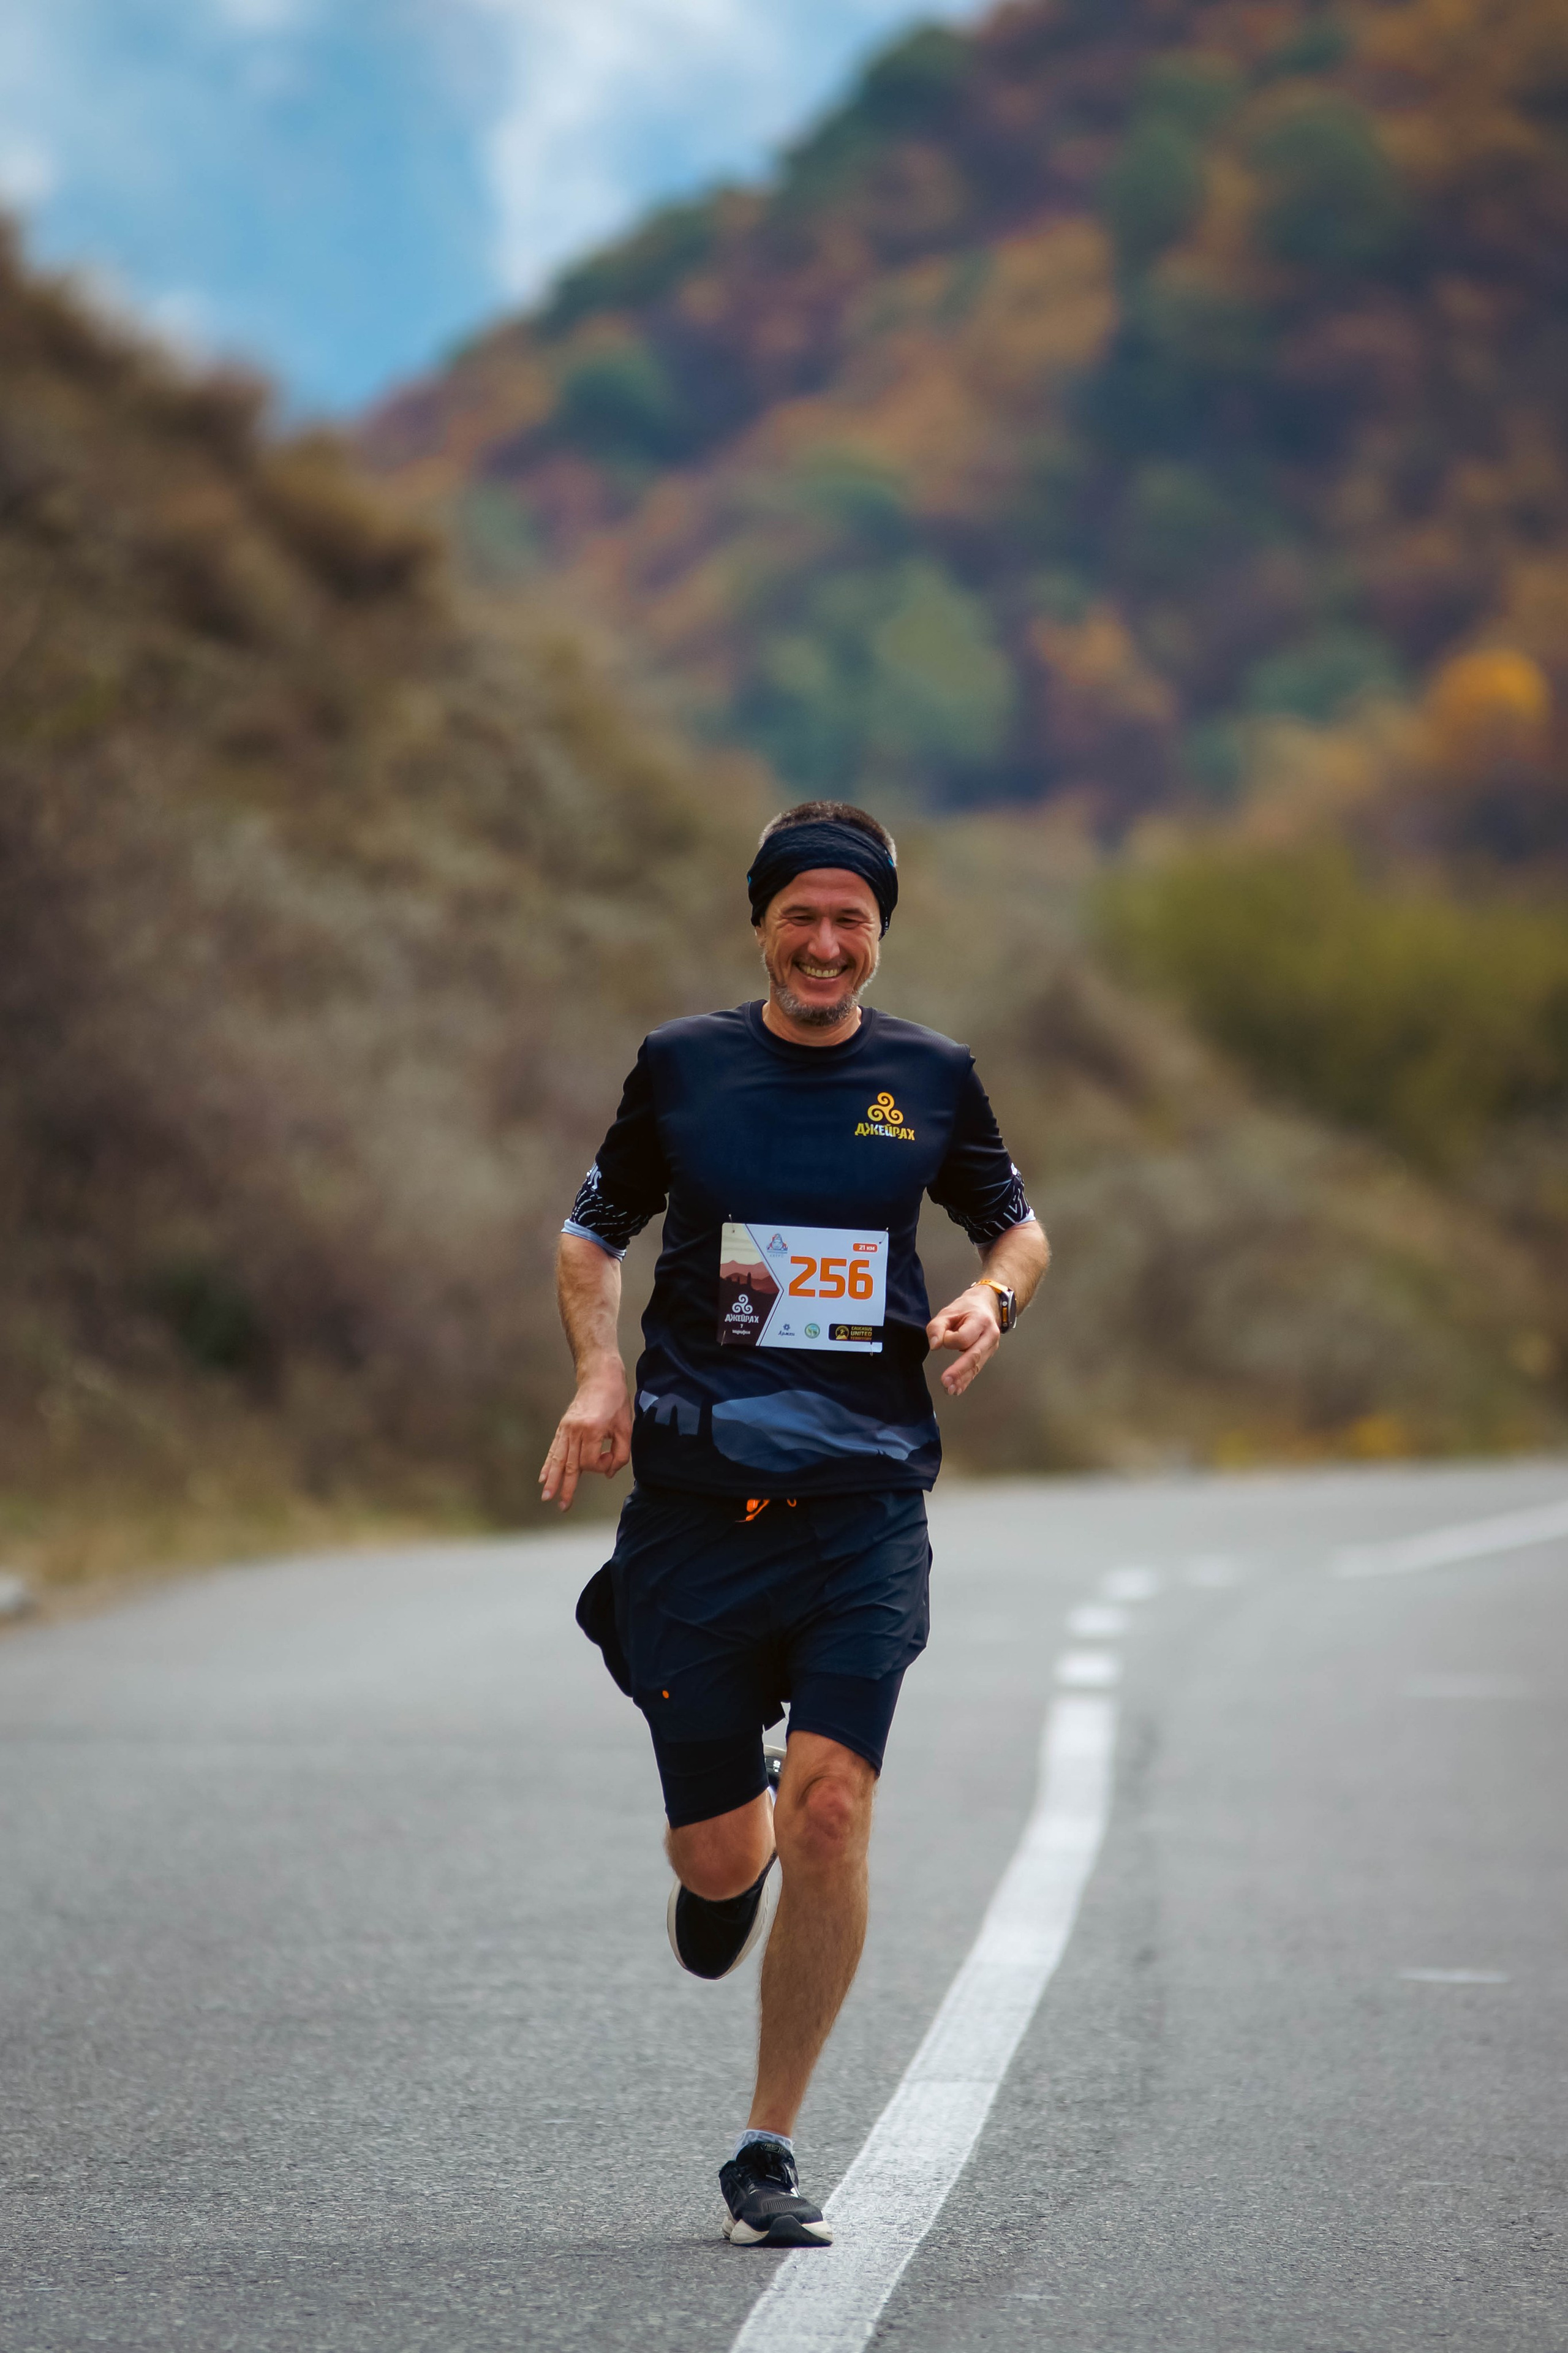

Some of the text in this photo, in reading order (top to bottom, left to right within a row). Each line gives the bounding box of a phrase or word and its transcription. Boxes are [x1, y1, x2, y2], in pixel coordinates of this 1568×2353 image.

[854, 1122, 915, 1141] ДЖЕЙРАХ
[788, 1256, 873, 1300] 256
[725, 1313, 759, 1323] ДЖЕЙРАХ
